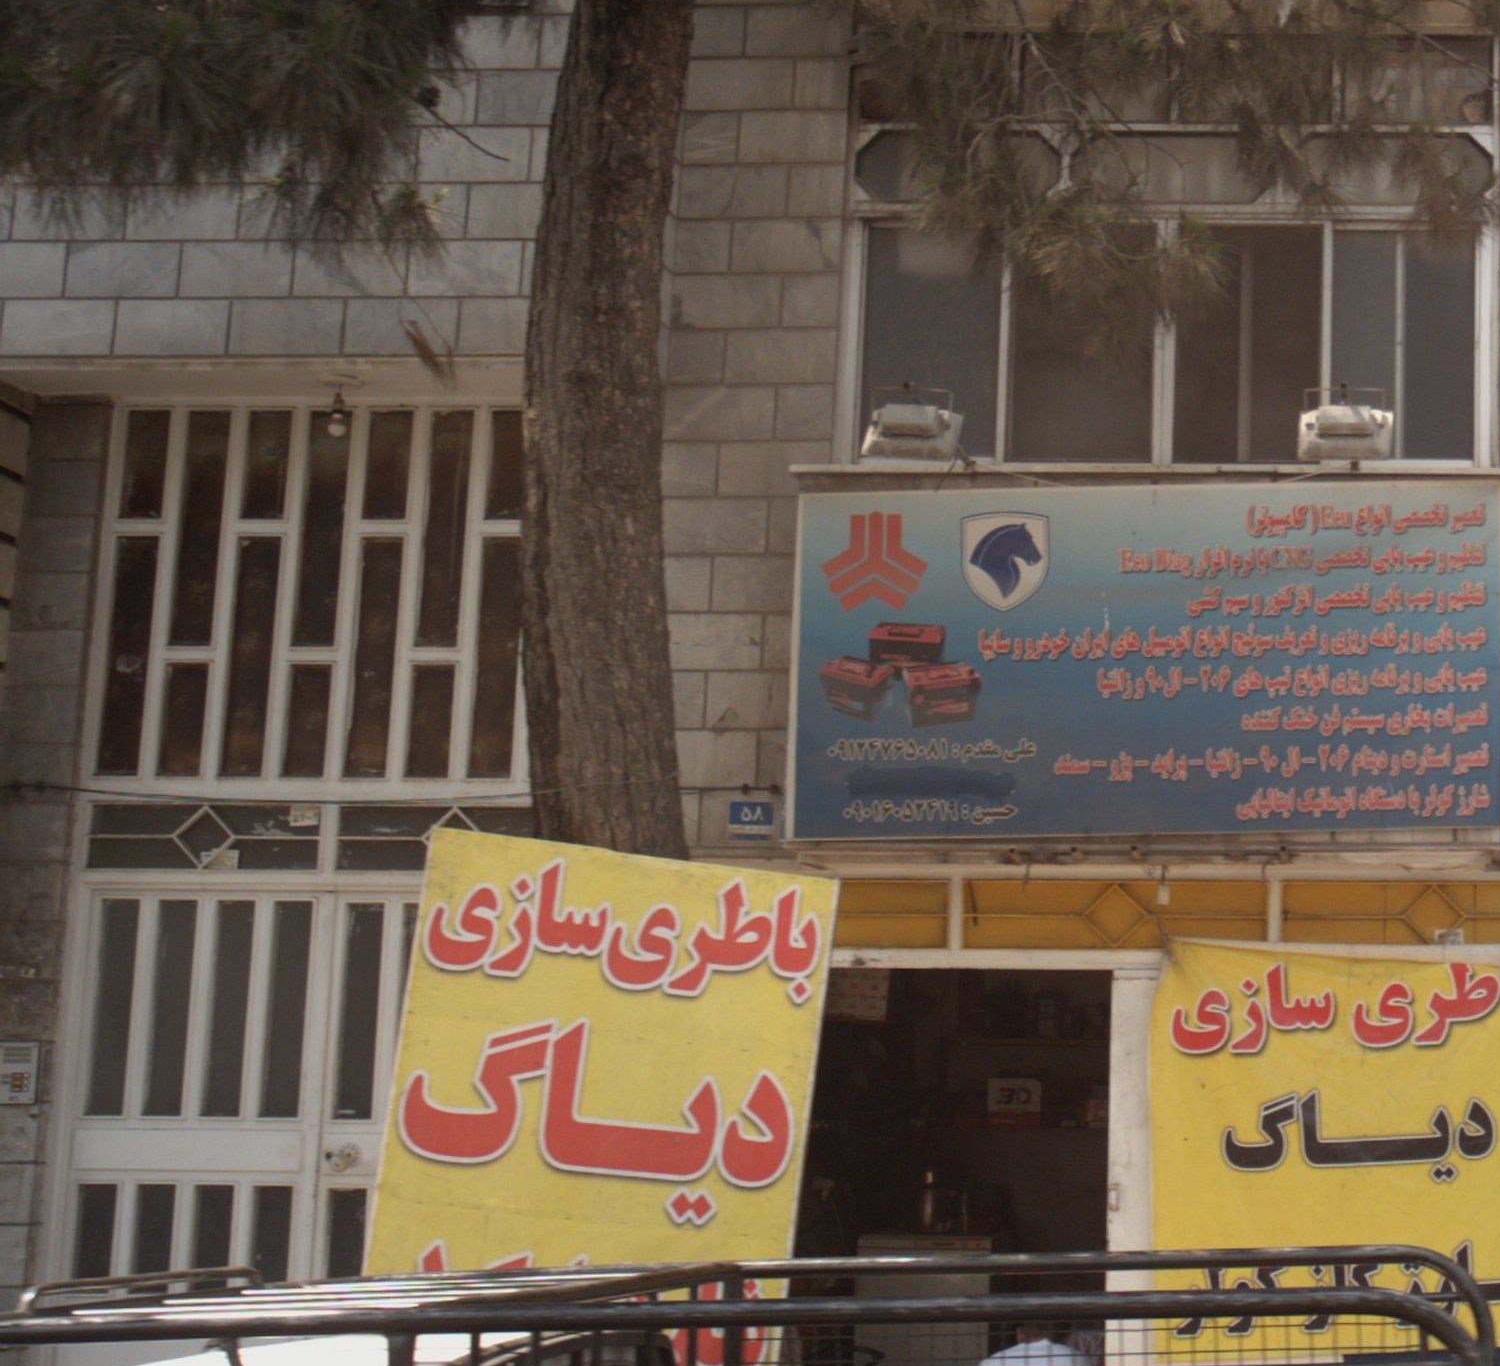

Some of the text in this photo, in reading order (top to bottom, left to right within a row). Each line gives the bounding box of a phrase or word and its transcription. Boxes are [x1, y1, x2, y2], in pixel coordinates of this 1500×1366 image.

[1354, 503, 1391, 535] انواع
[1391, 503, 1448, 534] تخصصی
[1194, 544, 1230, 578] افزار
[1230, 546, 1255, 578] نرم
[1268, 545, 1313, 571] CNG
[1314, 545, 1370, 575] تخصصی
[1371, 544, 1402, 573] یابی
[1404, 549, 1434, 572] عیب
[1435, 551, 1447, 573] و
[1447, 542, 1487, 572] تنظیم
[1185, 586, 1223, 618] کشی
[1222, 595, 1250, 617] سیم
[1250, 594, 1262, 617] و
[1314, 583, 1370, 615] تخصصی
[1371, 582, 1403, 613] یابی
[1404, 587, 1434, 612] عیب
[1435, 592, 1447, 615] و
[1447, 582, 1486, 613] تنظیم
[978, 627, 1012, 662] سایپا
[1024, 627, 1071, 661] خودرو
[1071, 626, 1110, 661] ایران
[1194, 624, 1232, 658] انواع
[1318, 632, 1329, 657] و
[1330, 628, 1370, 656] ریزی
[1370, 621, 1410, 656] برنامه
[1411, 629, 1422, 655] و
[1423, 621, 1457, 652] یابی
[1457, 626, 1487, 652] عیب
[1200, 664, 1232, 694] ۲۰۶
[1293, 664, 1330, 698] انواع
[1330, 668, 1370, 697] ریزی
[1370, 662, 1411, 697] برنامه
[1411, 671, 1423, 696] و
[1423, 661, 1457, 695] یابی
[1457, 667, 1487, 694] عیب
[1241, 701, 1489, 737] تعمیرات بخاری سیستم فن خنک کننده
[1003, 738, 1037, 764] علی
[1054, 752, 1091, 776] سمند
[1108, 750, 1134, 783] پژو
[1151, 747, 1188, 782] پراید
[1318, 743, 1350, 773] ۲۰۶
[1352, 744, 1389, 778] دینام
[1389, 753, 1400, 777] و
[1401, 742, 1451, 777] استارت
[1452, 742, 1489, 776] تعمیر
[741, 806, 764, 821] ۵۸
[1357, 785, 1406, 812] دستگاه
[1406, 784, 1421, 816] با
[1421, 783, 1456, 818] کولر
[1456, 783, 1490, 816] شارژ
[425, 858, 821, 1006] باطری سازی
[1170, 962, 1335, 1054] سازی
[401, 1018, 795, 1225] دیاگ
[1222, 1089, 1497, 1183] دیاگ
